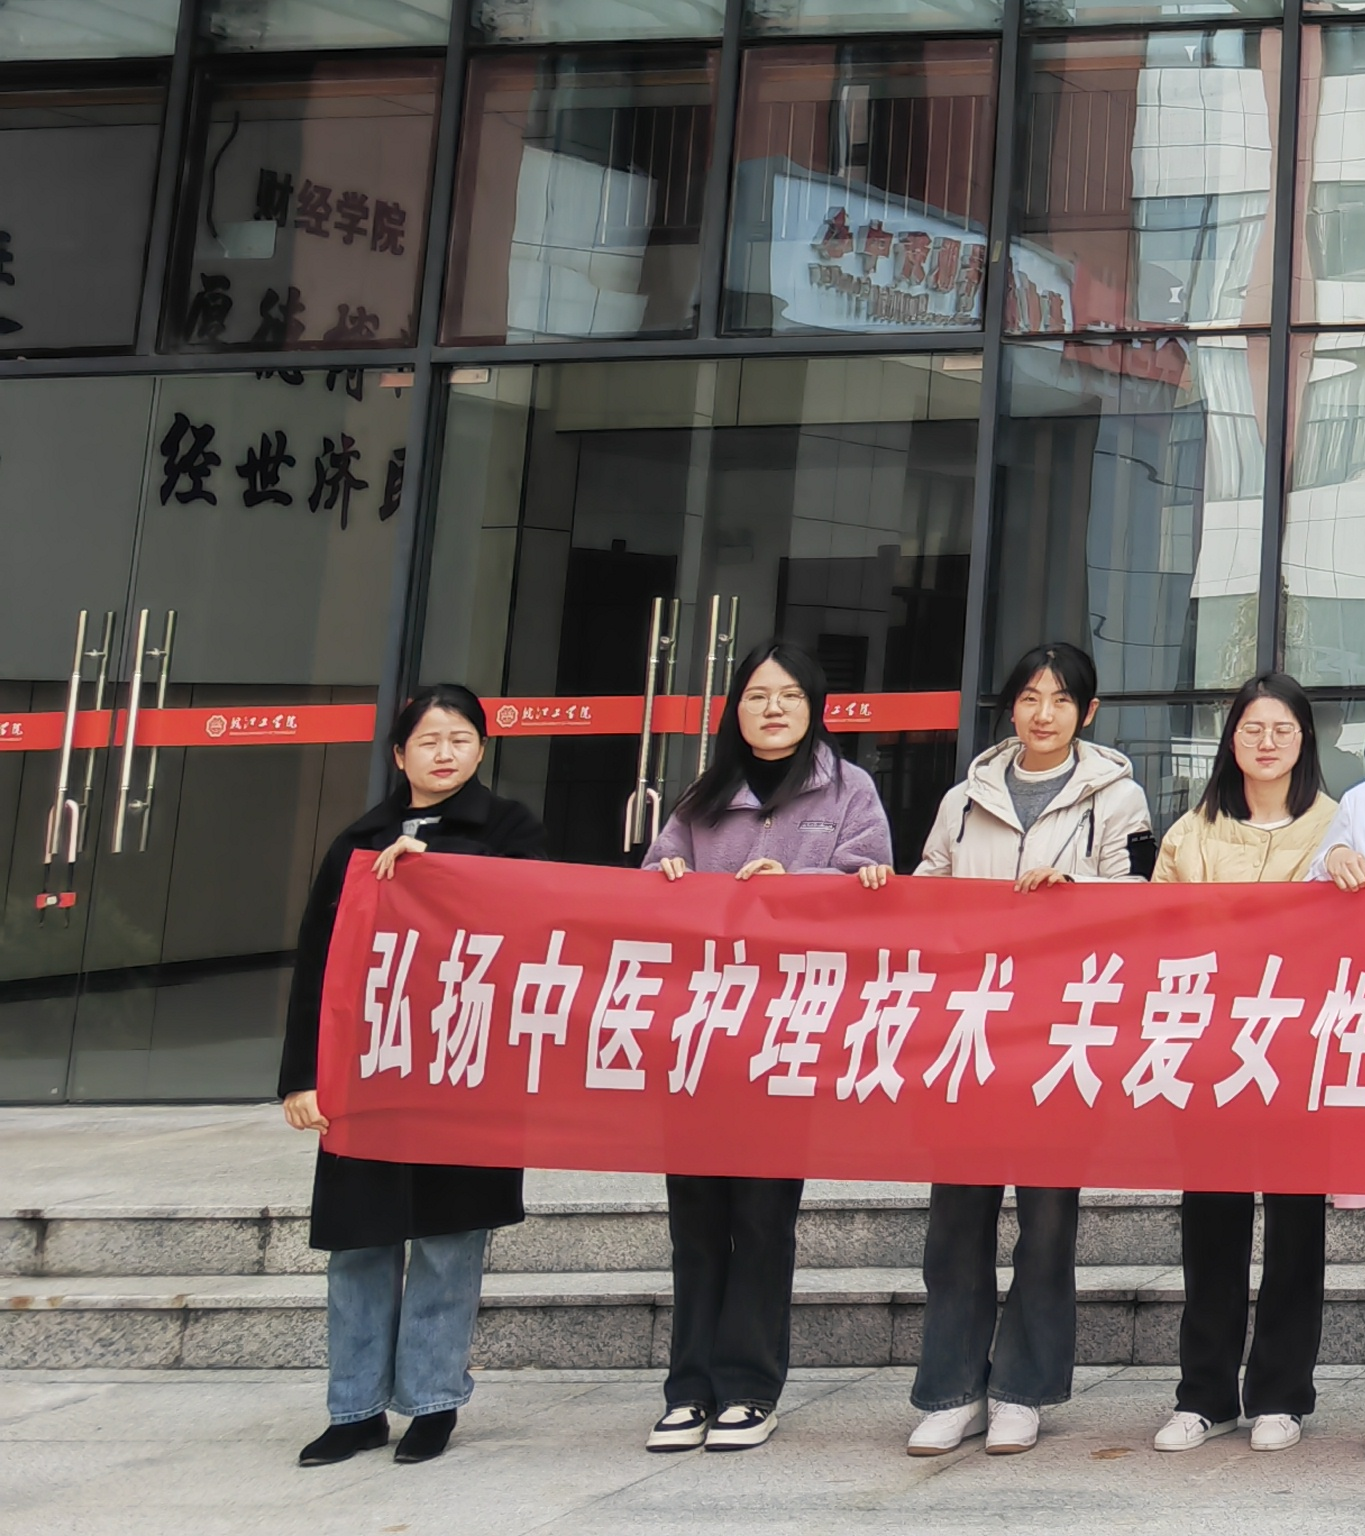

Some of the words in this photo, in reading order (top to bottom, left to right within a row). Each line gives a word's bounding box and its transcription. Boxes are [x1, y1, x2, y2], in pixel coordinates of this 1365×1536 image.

[253, 167, 407, 257] 财经学院
[360, 928, 1014, 1105] 弘扬中医护理技术
